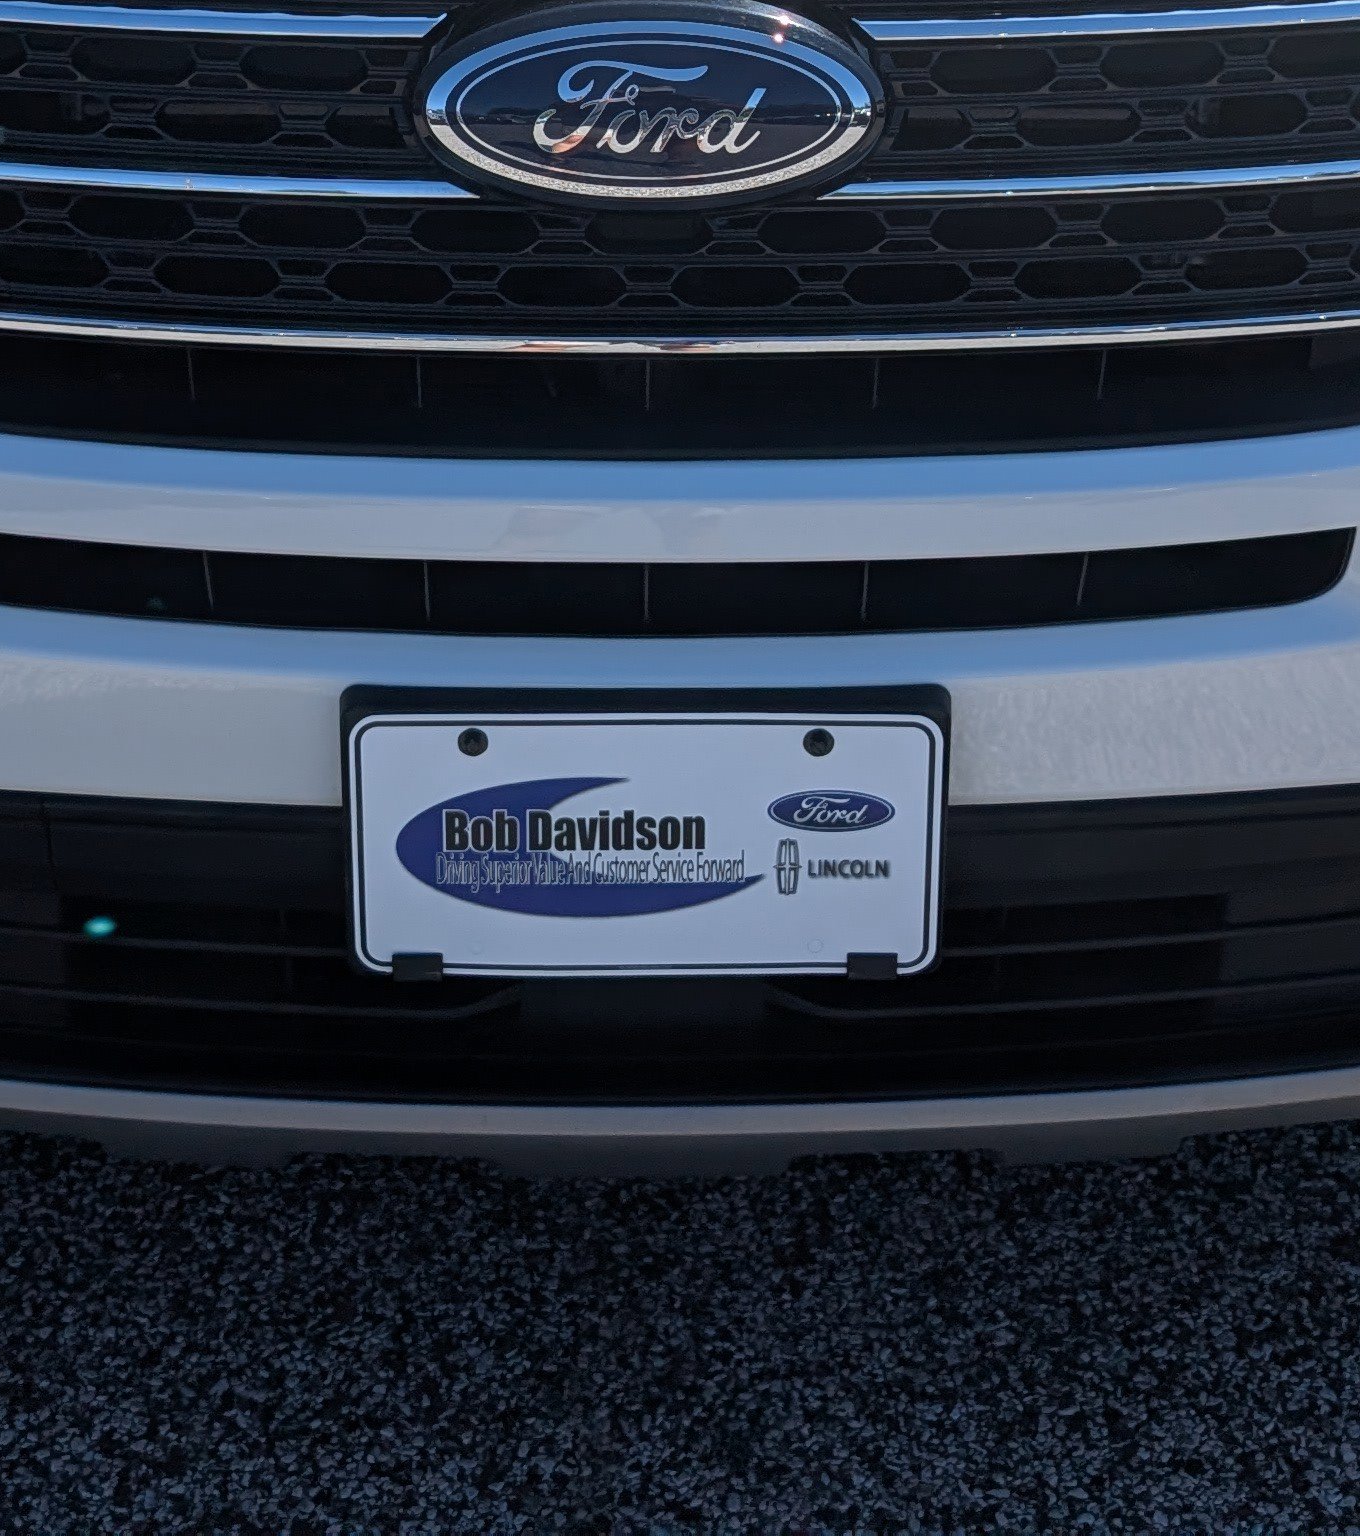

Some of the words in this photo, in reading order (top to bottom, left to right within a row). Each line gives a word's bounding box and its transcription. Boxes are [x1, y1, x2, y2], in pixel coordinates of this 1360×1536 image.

[533, 60, 766, 153] Ford
[444, 810, 519, 851] Bob
[528, 810, 706, 851] Davidson
[793, 796, 869, 824] Ford
[436, 851, 480, 893] Driving
[481, 851, 531, 893] Superior
[531, 852, 566, 884] Value
[567, 852, 591, 884] And
[593, 852, 651, 884] Customer
[652, 851, 694, 883] Service
[696, 850, 745, 883] Forward
[807, 859, 890, 878] LINCOLN
